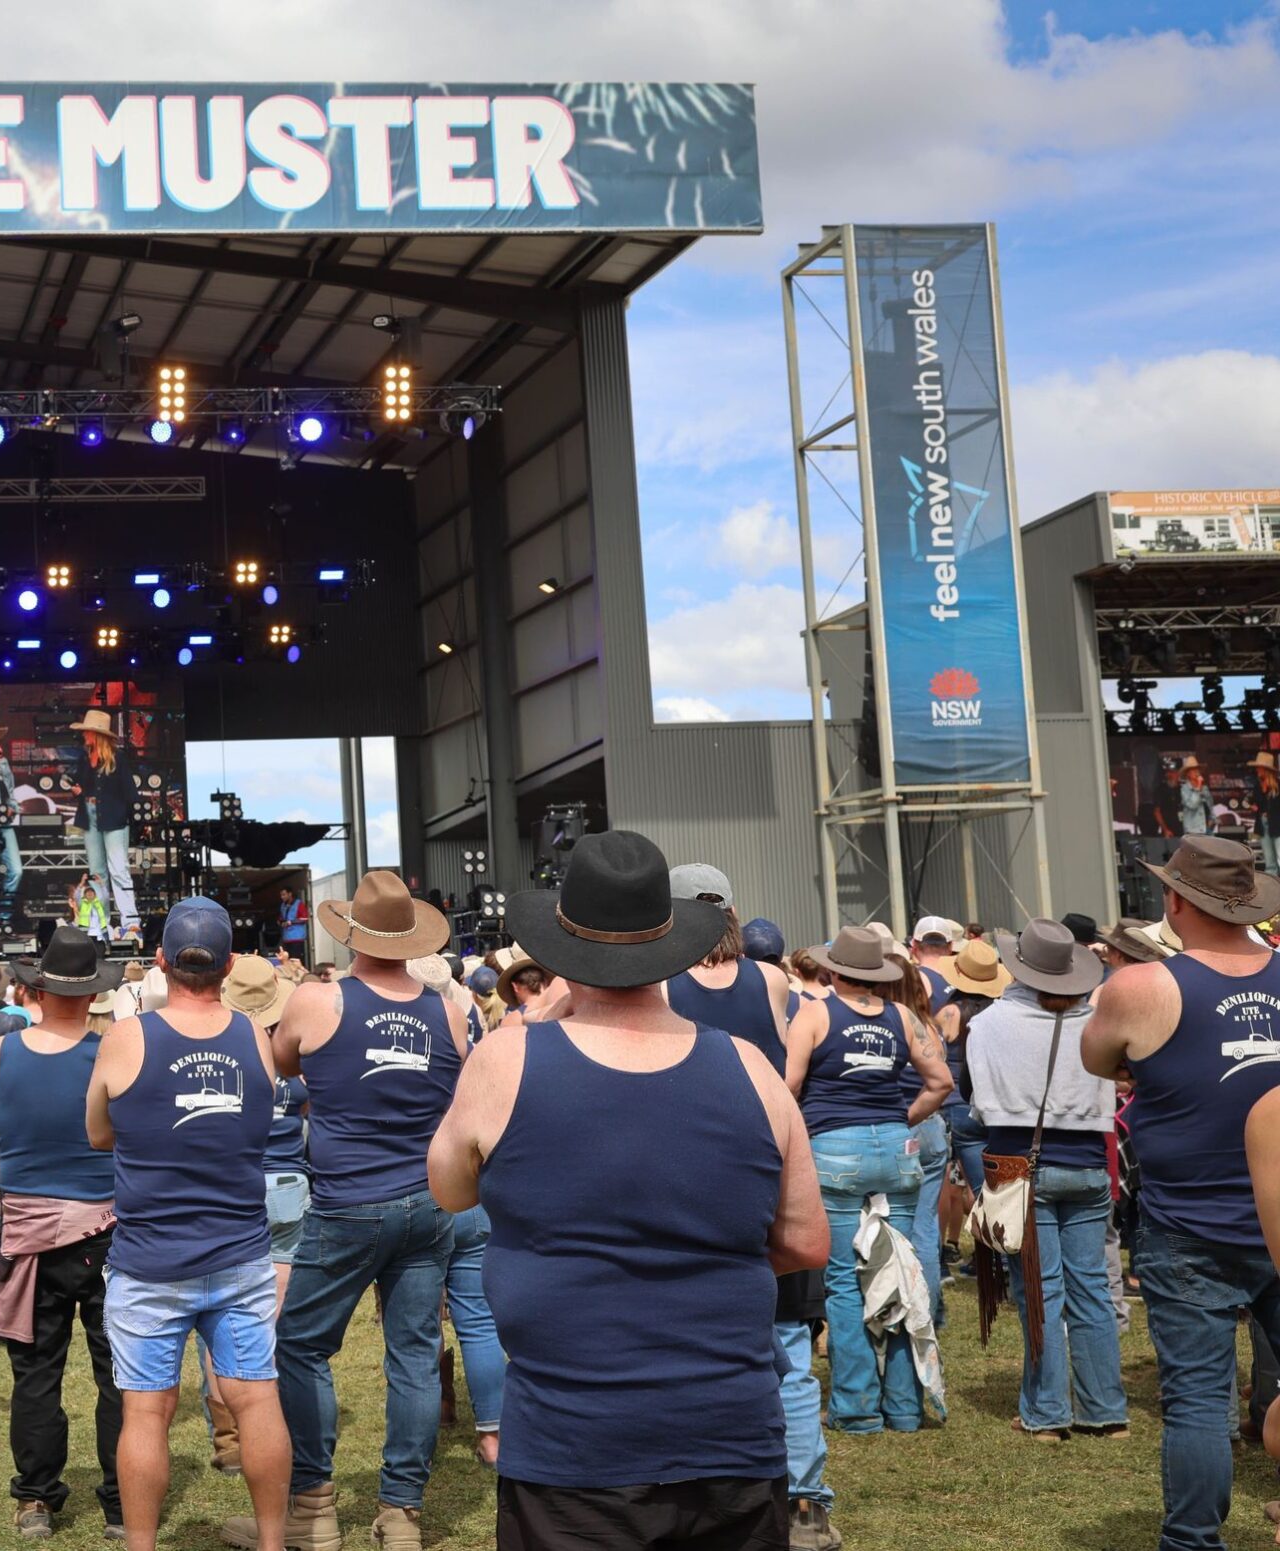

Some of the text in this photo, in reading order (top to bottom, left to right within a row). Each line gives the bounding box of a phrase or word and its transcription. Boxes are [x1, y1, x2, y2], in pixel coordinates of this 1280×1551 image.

[57, 95, 580, 213] MUSTER
[907, 269, 960, 622] feel new south wales
[1154, 492, 1212, 504] HISTORIC
[1214, 491, 1265, 502] VEHICLE
[931, 700, 981, 719] NSW
[1242, 1006, 1260, 1015] UTE
[365, 1012, 428, 1032] DENILIQUIN
[390, 1024, 405, 1032] UTE
[169, 1052, 239, 1074] DENILIQUIN
[196, 1064, 214, 1072] UTE
